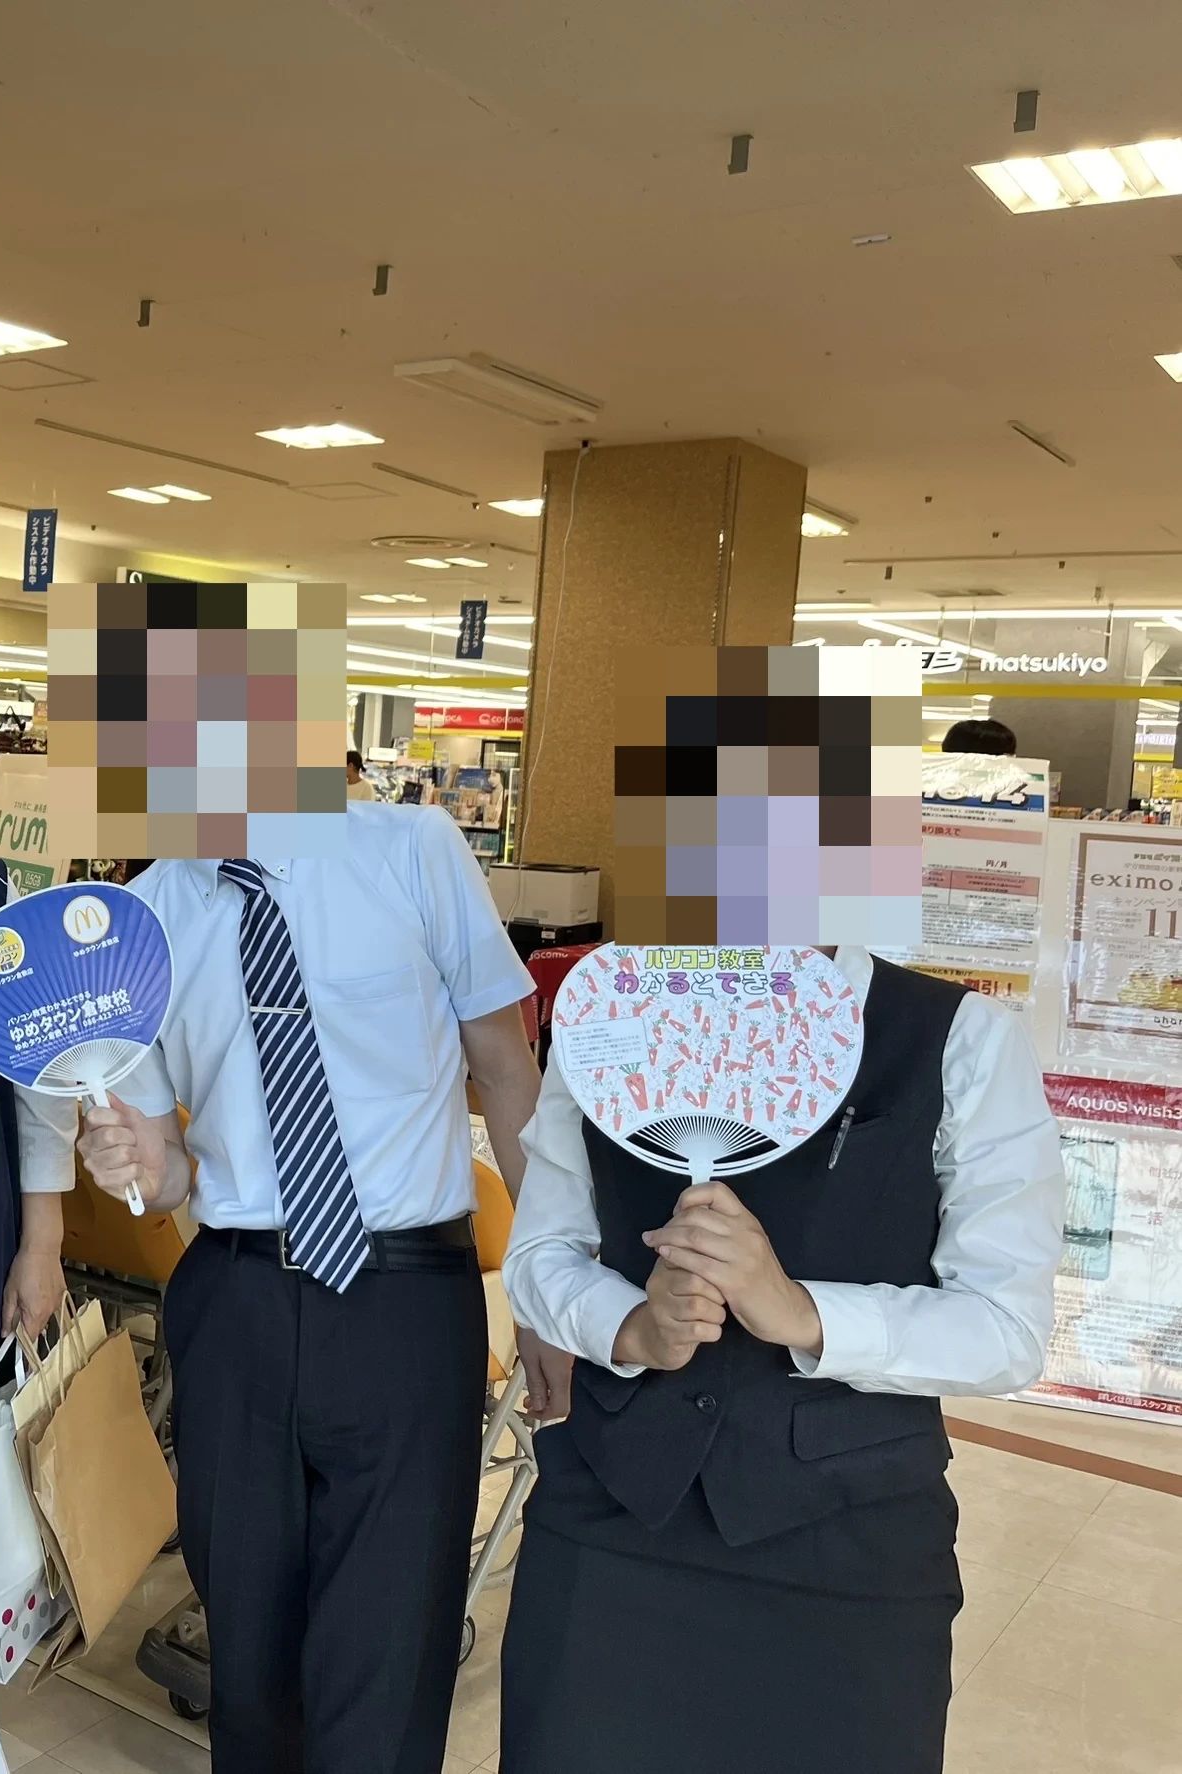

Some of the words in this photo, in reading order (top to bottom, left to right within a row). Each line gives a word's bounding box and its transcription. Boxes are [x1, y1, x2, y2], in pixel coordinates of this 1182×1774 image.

[28, 517, 40, 586] システム作動中
[40, 516, 51, 576] ビデオカメラ
[980, 652, 1108, 677] matsukiyo
[1090, 873, 1173, 891] eximo
[644, 948, 765, 971] パソコン教室
[614, 972, 795, 996] わかるとできる
[10, 988, 130, 1042] ゆめタウン倉敷校
[1066, 1096, 1128, 1114] AQUOS
